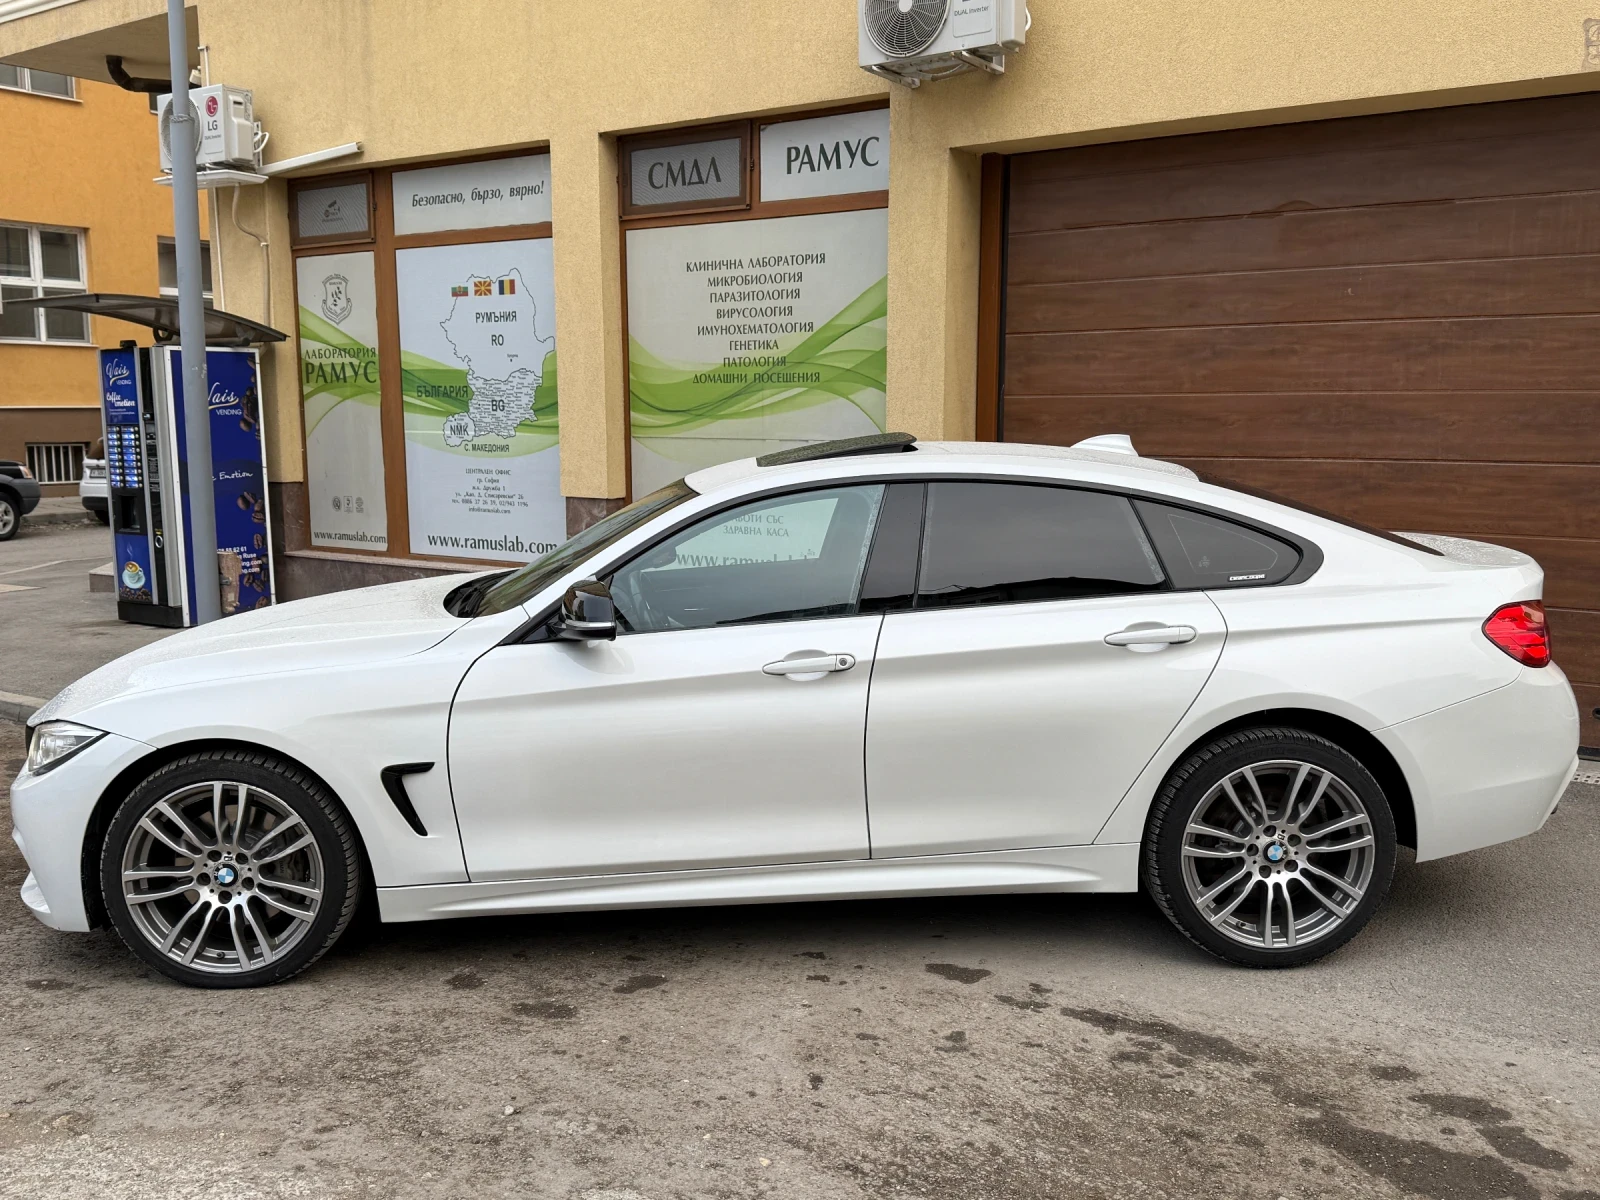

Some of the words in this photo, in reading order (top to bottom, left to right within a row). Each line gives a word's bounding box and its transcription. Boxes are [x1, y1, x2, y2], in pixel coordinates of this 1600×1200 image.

[968, 5, 989, 15] Inverter
[207, 120, 218, 131] LG
[786, 136, 880, 175] РАМУС
[648, 156, 722, 190] СМДЛ
[412, 192, 466, 208] Безопасно,
[471, 187, 504, 205] бързо,
[509, 180, 545, 201] вярно!
[686, 257, 744, 273] КЛИНИЧНА
[747, 252, 826, 270] ЛАБОРАТОРИЯ
[707, 271, 803, 288] МИКРОБИОЛОГИЯ
[709, 288, 801, 304] ПАРАЗИТОЛОГИЯ
[475, 310, 517, 324] РУМЪНИЯ
[716, 305, 793, 320] ВИРУСОЛОГИЯ
[697, 322, 814, 337] ИМУНОХЕМАТОЛОГИЯ
[491, 334, 505, 347] RO
[729, 340, 779, 351] ГЕНЕТИКА
[304, 347, 377, 361] ЛАБОРАТОРИЯ
[723, 356, 787, 368] ПАТОЛОГИЯ
[305, 360, 378, 385] РАМУС
[692, 373, 748, 384] ДОМАШНИ
[416, 385, 469, 398] БЪЛГАРИЯ
[215, 408, 243, 416] VENDING
[491, 399, 505, 412] BG
[450, 424, 469, 436] NMK
[472, 443, 510, 454] МАКЕДОНИЯ
[219, 469, 254, 480] Emotion
[314, 530, 387, 544] www.ramuslab.com
[723, 525, 762, 535] ЗДРАВНА
[767, 527, 790, 537] КАСА
[427, 534, 558, 554] www.ramuslab.com
